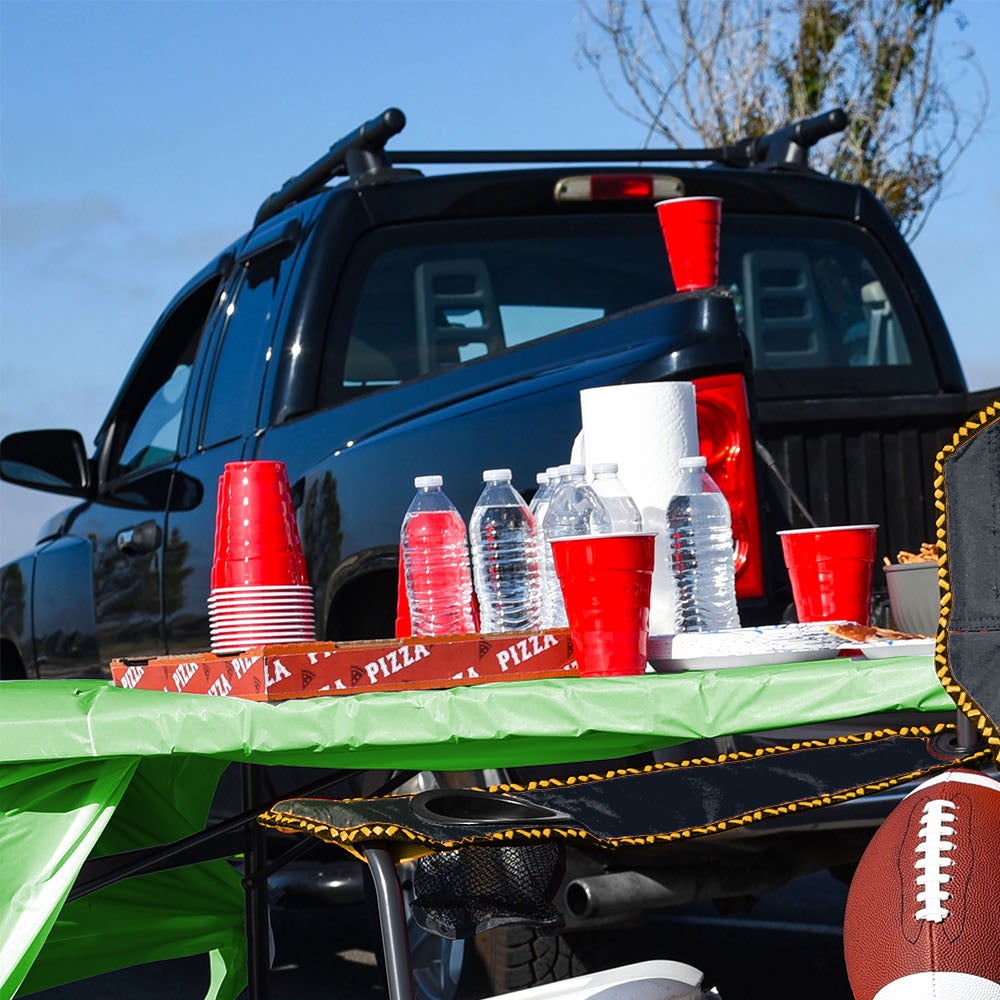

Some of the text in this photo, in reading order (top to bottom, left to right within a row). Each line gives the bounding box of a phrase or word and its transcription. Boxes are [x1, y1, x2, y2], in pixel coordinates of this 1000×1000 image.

[364, 643, 431, 684] PIZZA
[495, 633, 559, 672] PIZZA
[172, 662, 199, 693] PIZZA
